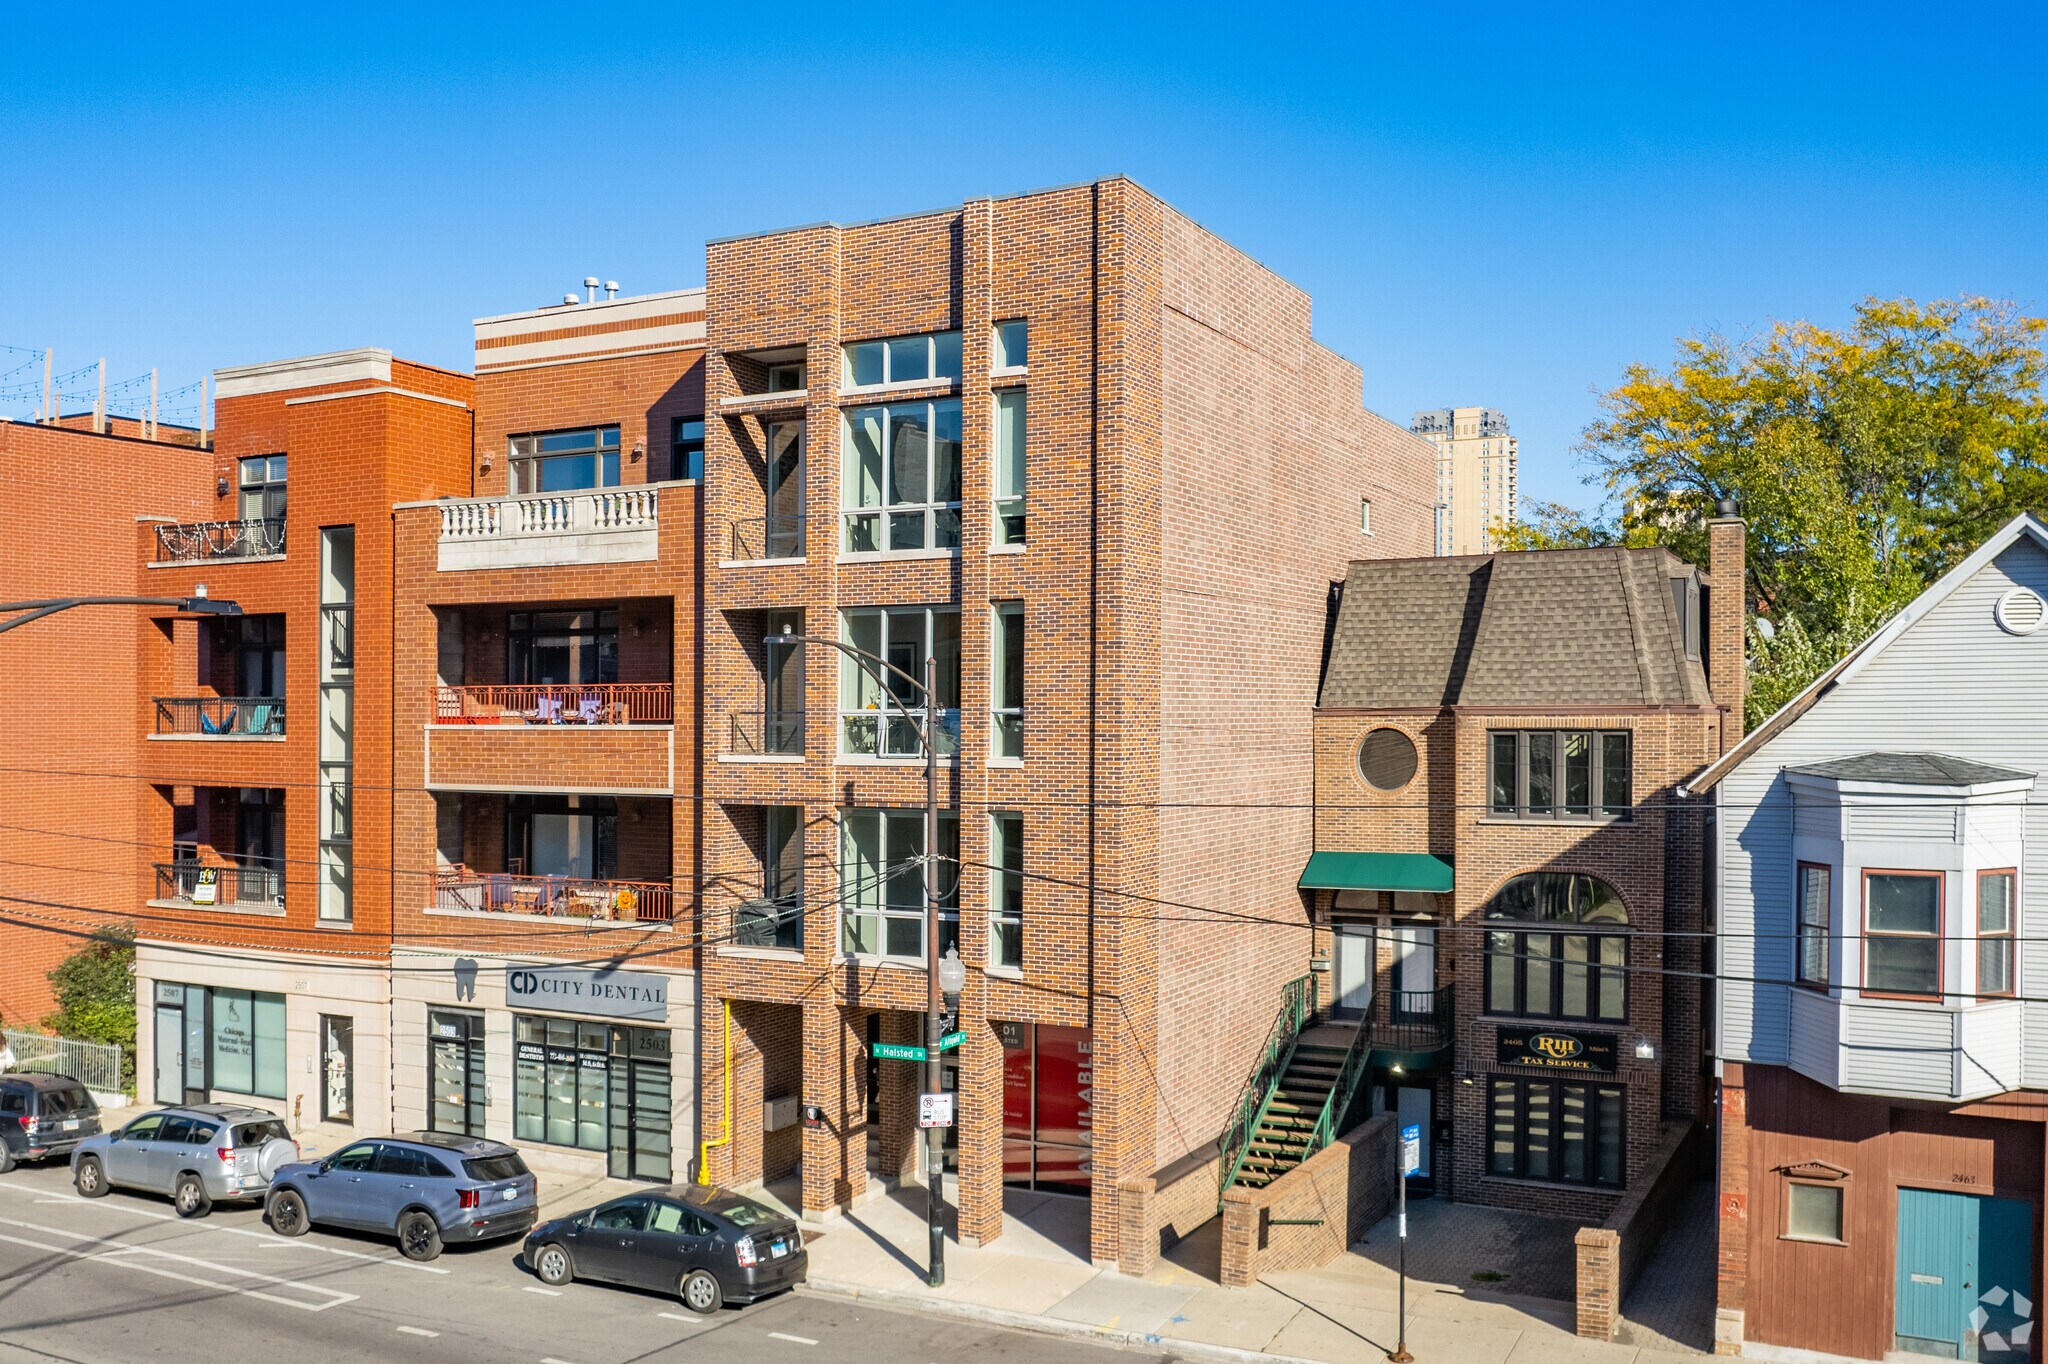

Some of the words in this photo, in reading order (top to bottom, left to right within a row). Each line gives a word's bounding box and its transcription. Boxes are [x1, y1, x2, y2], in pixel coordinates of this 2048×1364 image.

[295, 981, 308, 991] 2507
[541, 979, 583, 995] CITY
[591, 983, 665, 1003] DENTAL
[163, 988, 179, 997] 2507
[224, 1027, 245, 1037] Chicago
[1003, 1026, 1016, 1036] 01
[520, 1045, 544, 1054] GENERAL
[640, 1038, 665, 1051] 2503
[883, 1047, 913, 1058] Halsted
[1521, 1056, 1543, 1064] TAX
[1546, 1059, 1589, 1069] SERVICE
[1952, 1173, 1976, 1184] 2463
